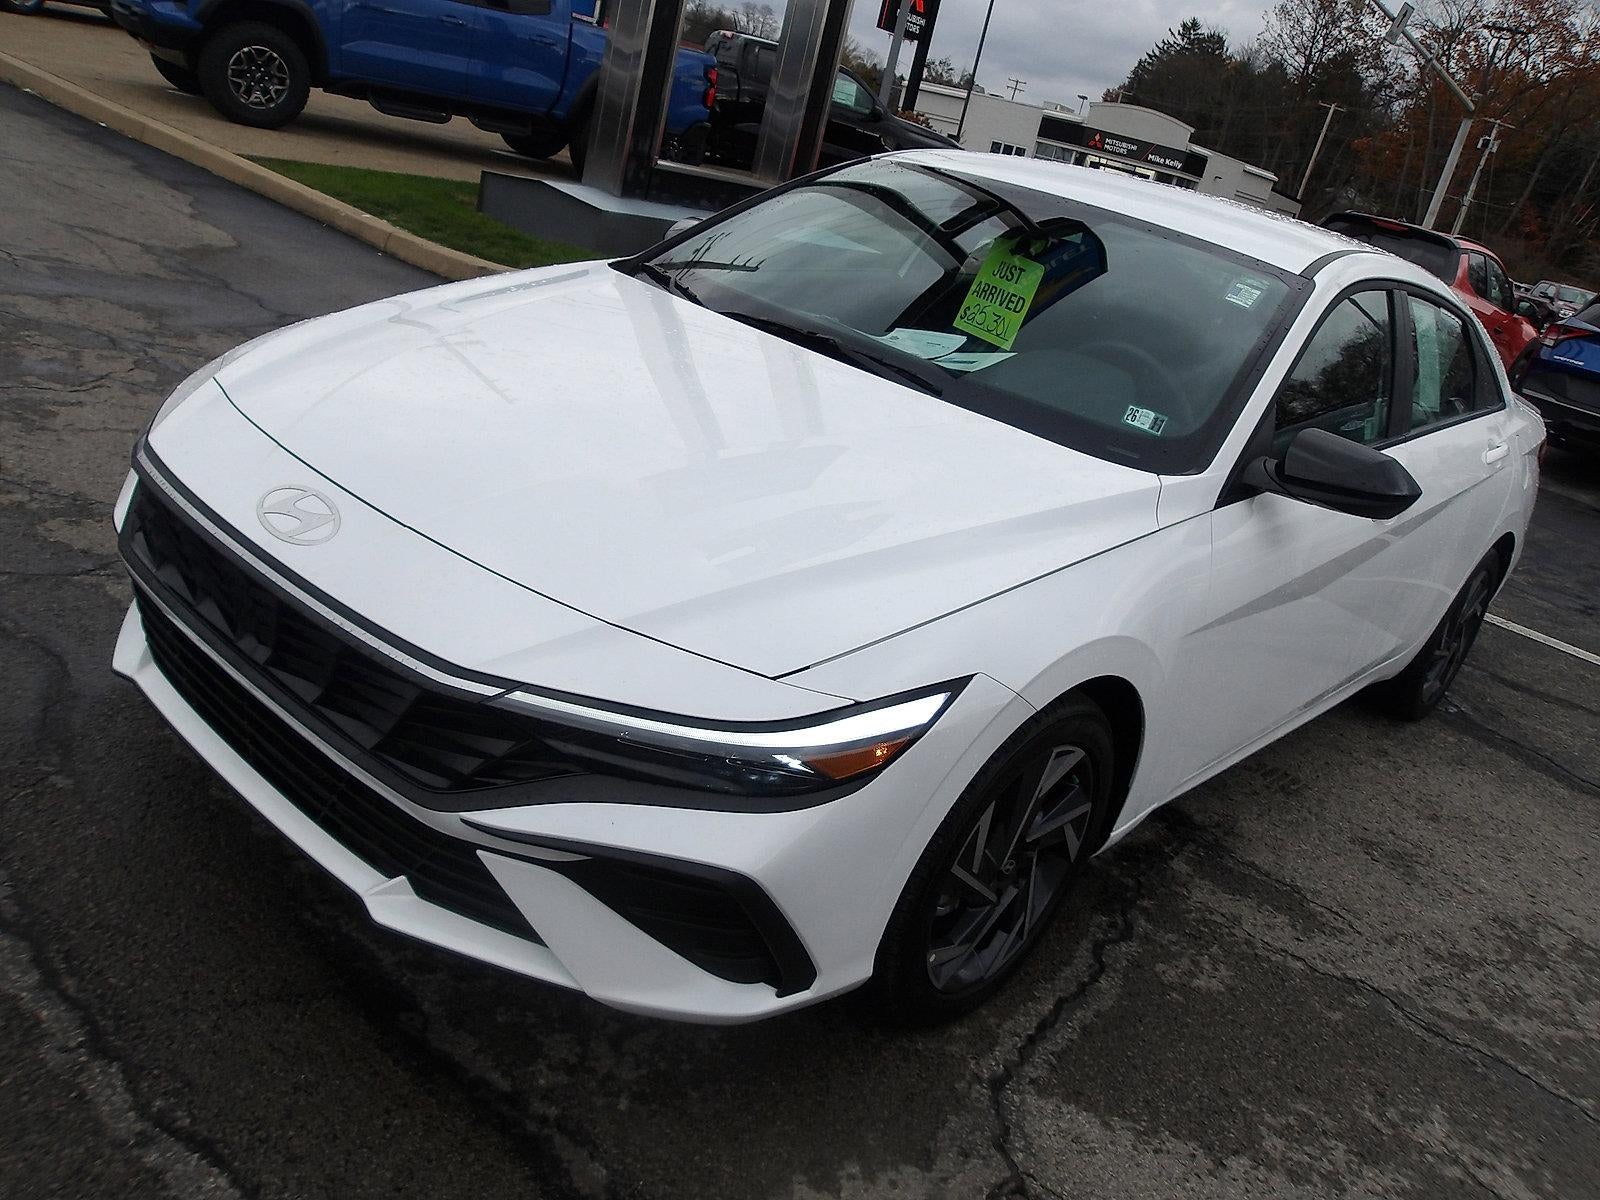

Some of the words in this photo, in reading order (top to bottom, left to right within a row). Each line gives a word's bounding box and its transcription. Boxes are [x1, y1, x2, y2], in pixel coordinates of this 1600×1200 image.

[1104, 144, 1127, 155] MOTORS
[1105, 138, 1138, 151] MITSUBISHI
[1148, 153, 1165, 163] Mike
[1165, 159, 1183, 169] Kelly
[992, 261, 1026, 284] JUST
[972, 281, 1026, 314] ARRIVED
[1125, 407, 1140, 423] 26
